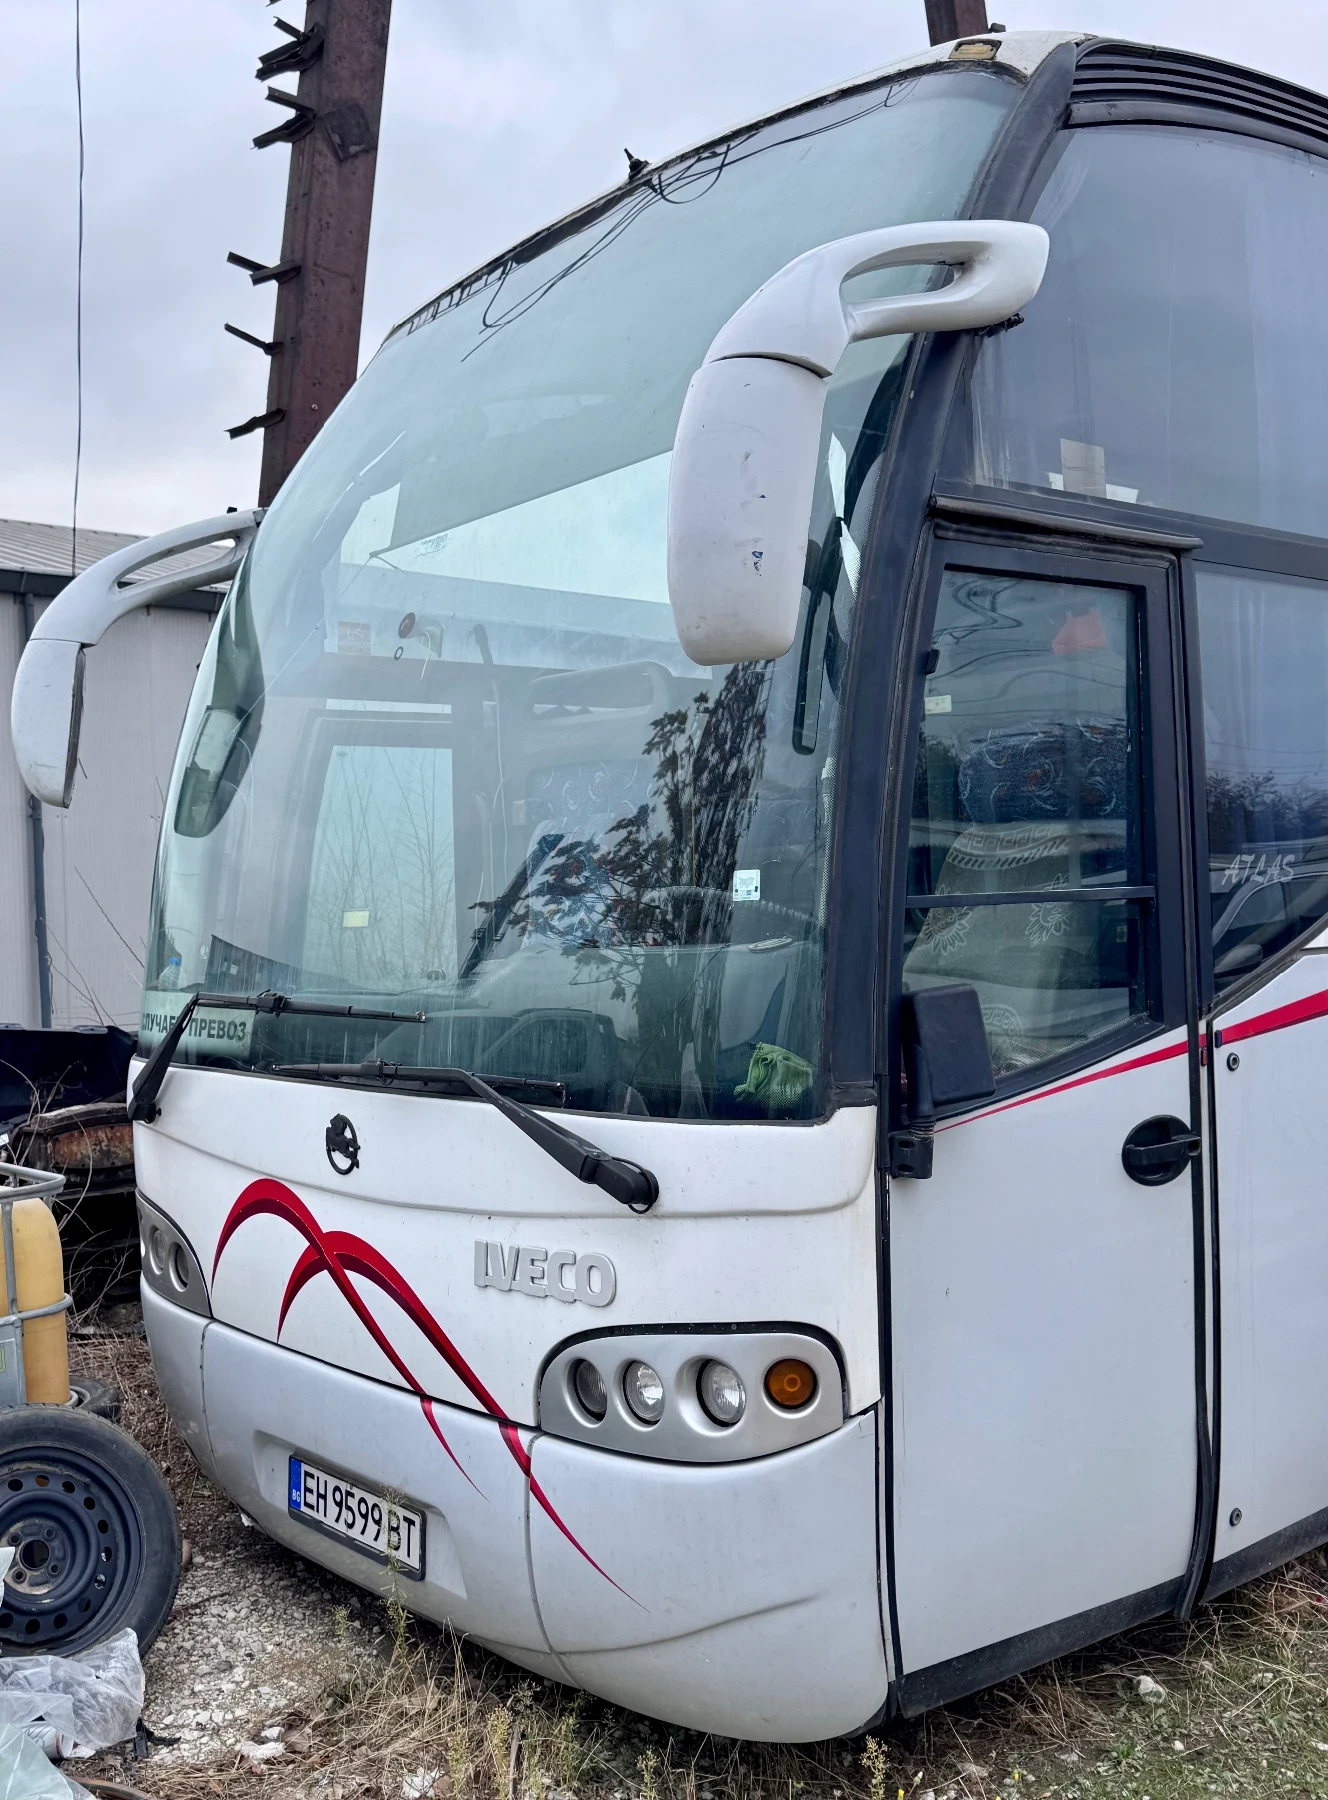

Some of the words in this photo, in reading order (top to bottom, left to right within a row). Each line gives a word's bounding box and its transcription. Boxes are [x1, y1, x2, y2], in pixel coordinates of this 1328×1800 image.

[1221, 853, 1295, 885] ATLAS
[189, 1017, 247, 1041] ПРЕВОЗ
[474, 1238, 617, 1307] IVECO
[292, 1488, 301, 1503] BG
